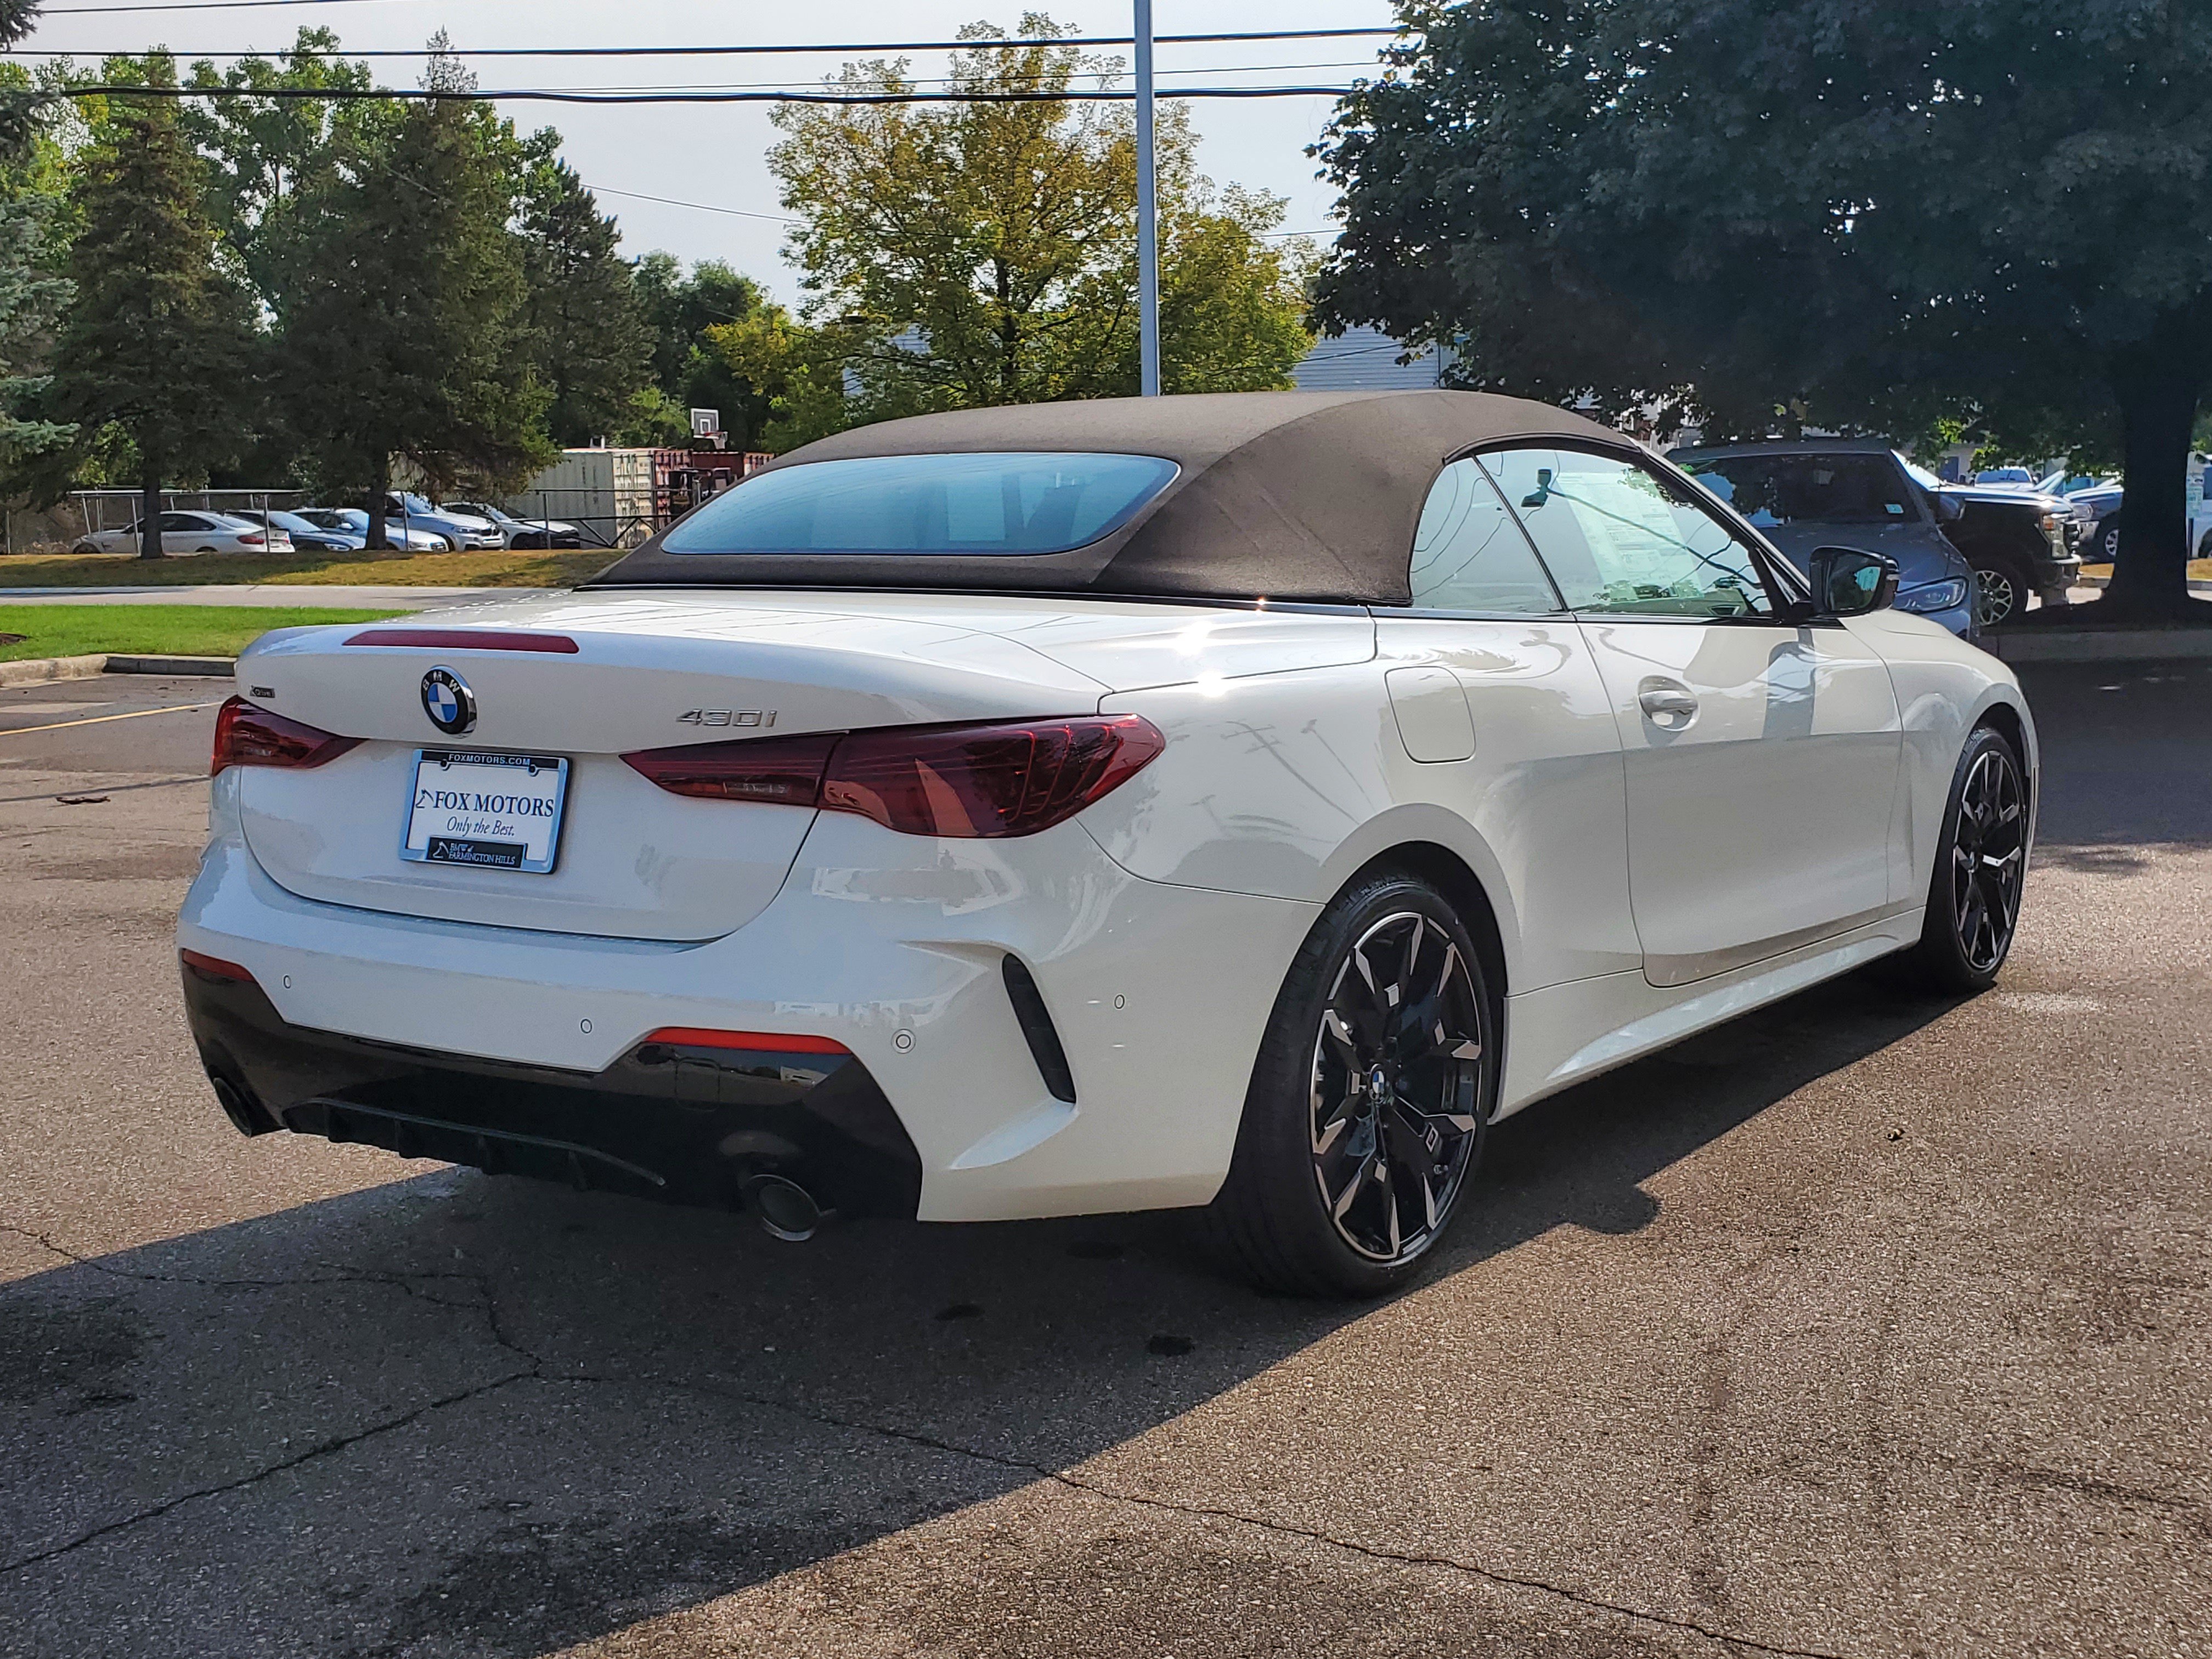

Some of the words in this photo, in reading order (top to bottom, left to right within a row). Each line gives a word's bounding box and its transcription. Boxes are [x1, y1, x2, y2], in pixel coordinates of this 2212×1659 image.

[422, 671, 460, 692] BMW
[676, 708, 777, 727] 430i
[448, 754, 531, 766] FOXMOTORS.COM
[433, 791, 471, 811] FOX
[473, 794, 554, 817] MOTORS
[447, 816, 472, 837] Only
[473, 817, 490, 834] the
[492, 820, 515, 837] Best.
[448, 851, 494, 863] FARMINGTON
[495, 855, 516, 865] HILLS
